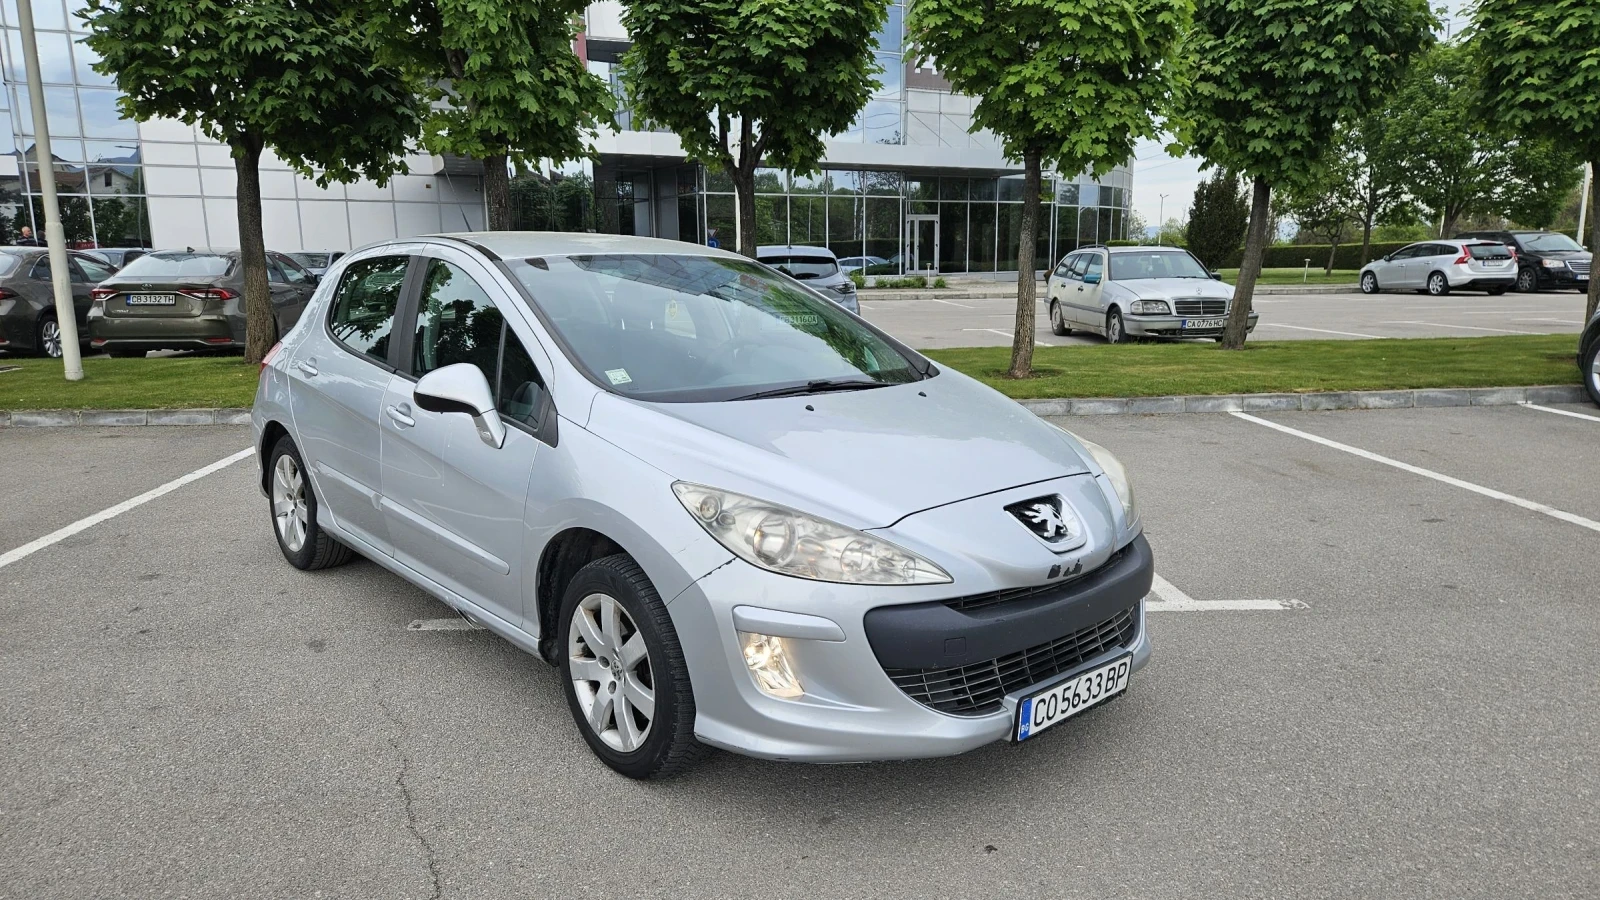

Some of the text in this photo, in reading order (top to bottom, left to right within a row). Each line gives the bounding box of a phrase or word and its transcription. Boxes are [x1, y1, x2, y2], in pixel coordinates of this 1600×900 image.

[1187, 320, 1196, 328] CA
[1197, 320, 1212, 328] 0776
[1060, 672, 1104, 714] 5633
[1104, 662, 1127, 694] BP
